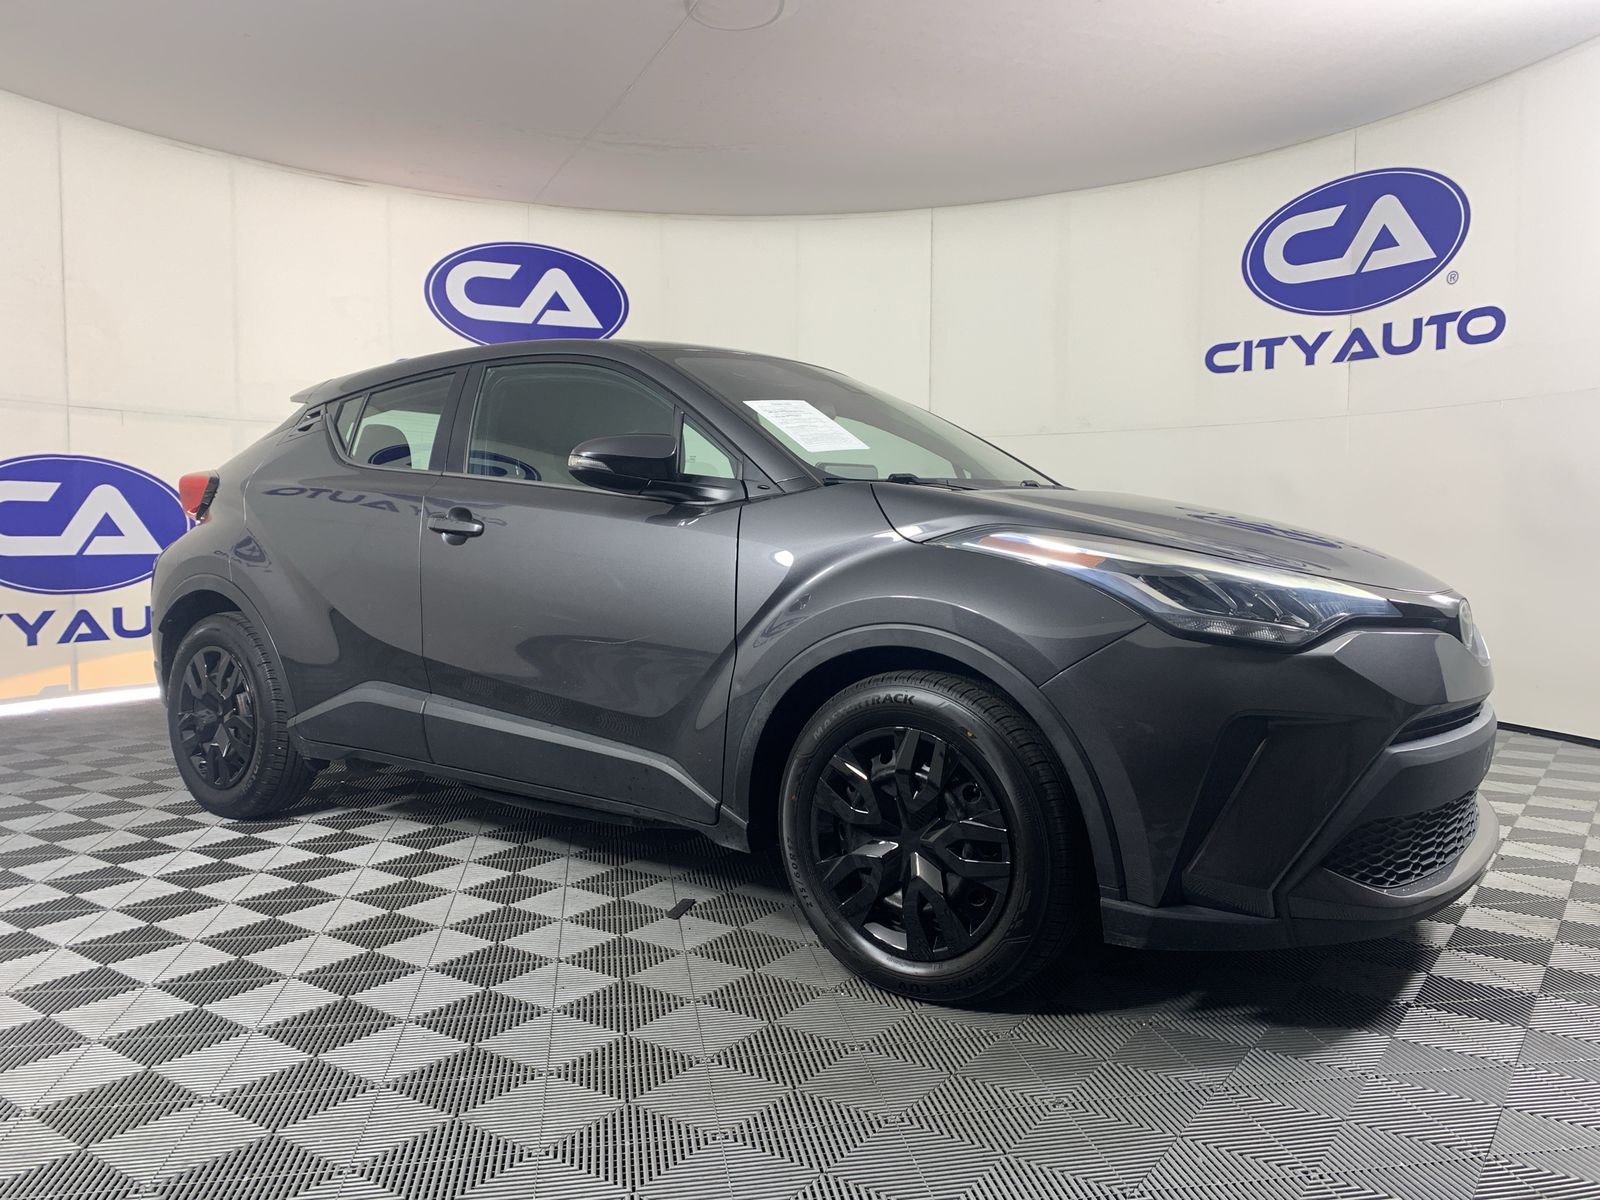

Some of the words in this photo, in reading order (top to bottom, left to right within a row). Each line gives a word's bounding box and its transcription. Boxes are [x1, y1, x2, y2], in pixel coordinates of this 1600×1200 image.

[1263, 194, 1438, 285] CA
[445, 260, 604, 329] CA
[1204, 331, 1333, 374] CITY
[1332, 306, 1507, 364] AUTO
